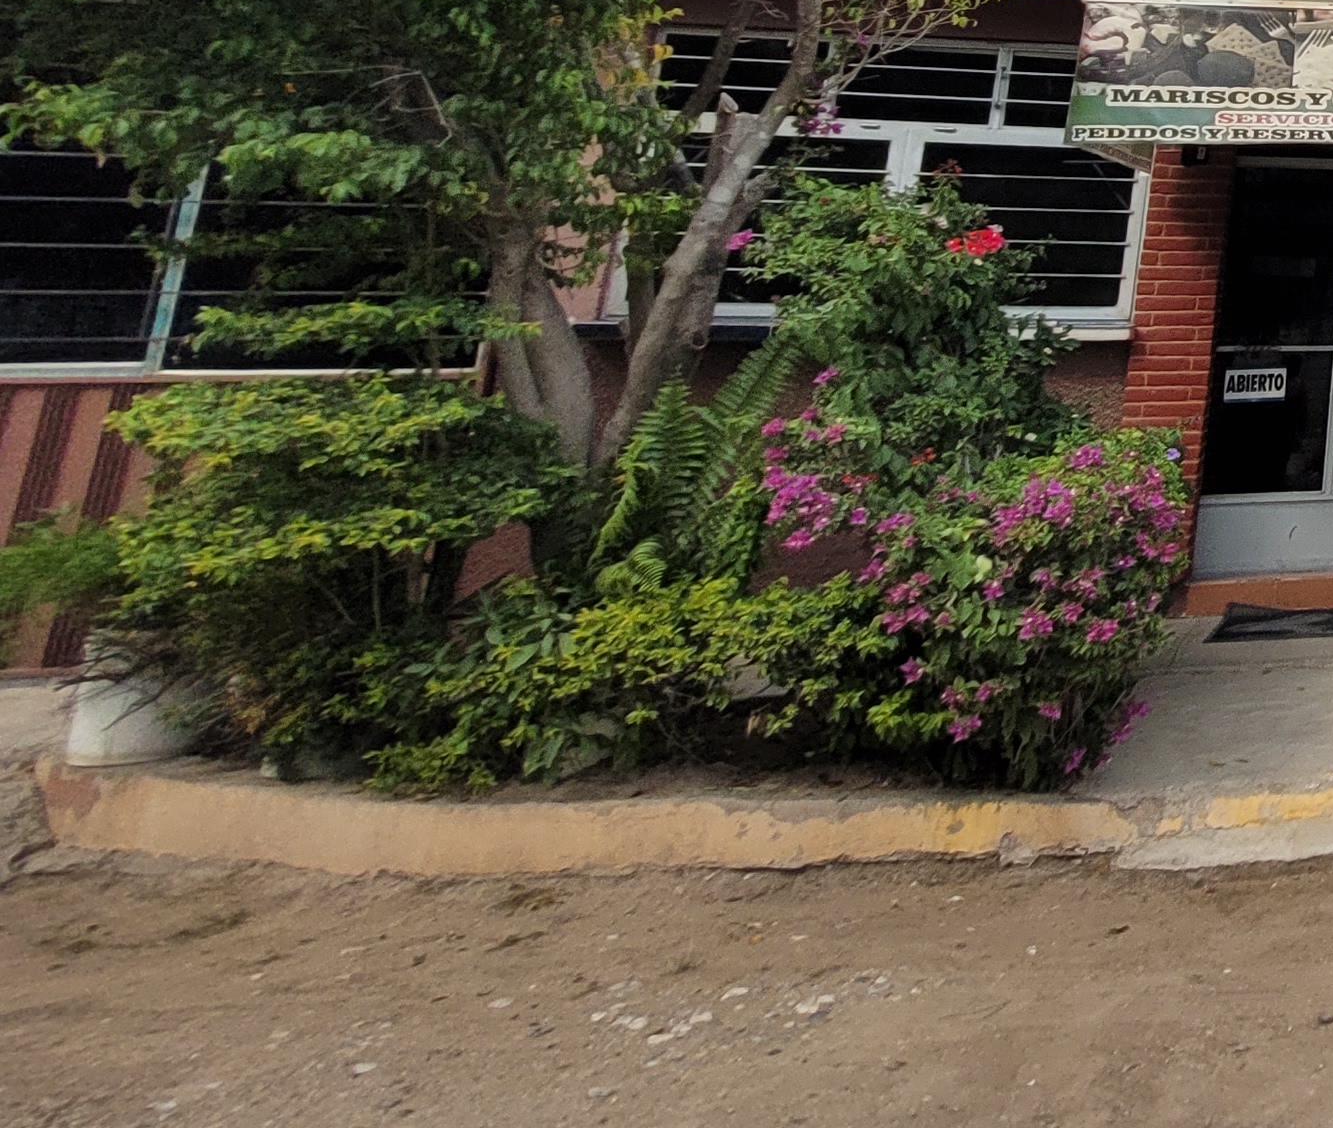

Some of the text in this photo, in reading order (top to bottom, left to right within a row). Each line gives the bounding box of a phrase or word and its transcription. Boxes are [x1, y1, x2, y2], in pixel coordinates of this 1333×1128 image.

[1110, 88, 1297, 106] MARISCOS
[1304, 92, 1328, 106] Y
[1072, 127, 1197, 140] PEDIDOS
[1203, 128, 1223, 140] Y
[1226, 373, 1284, 393] ABIERTO
